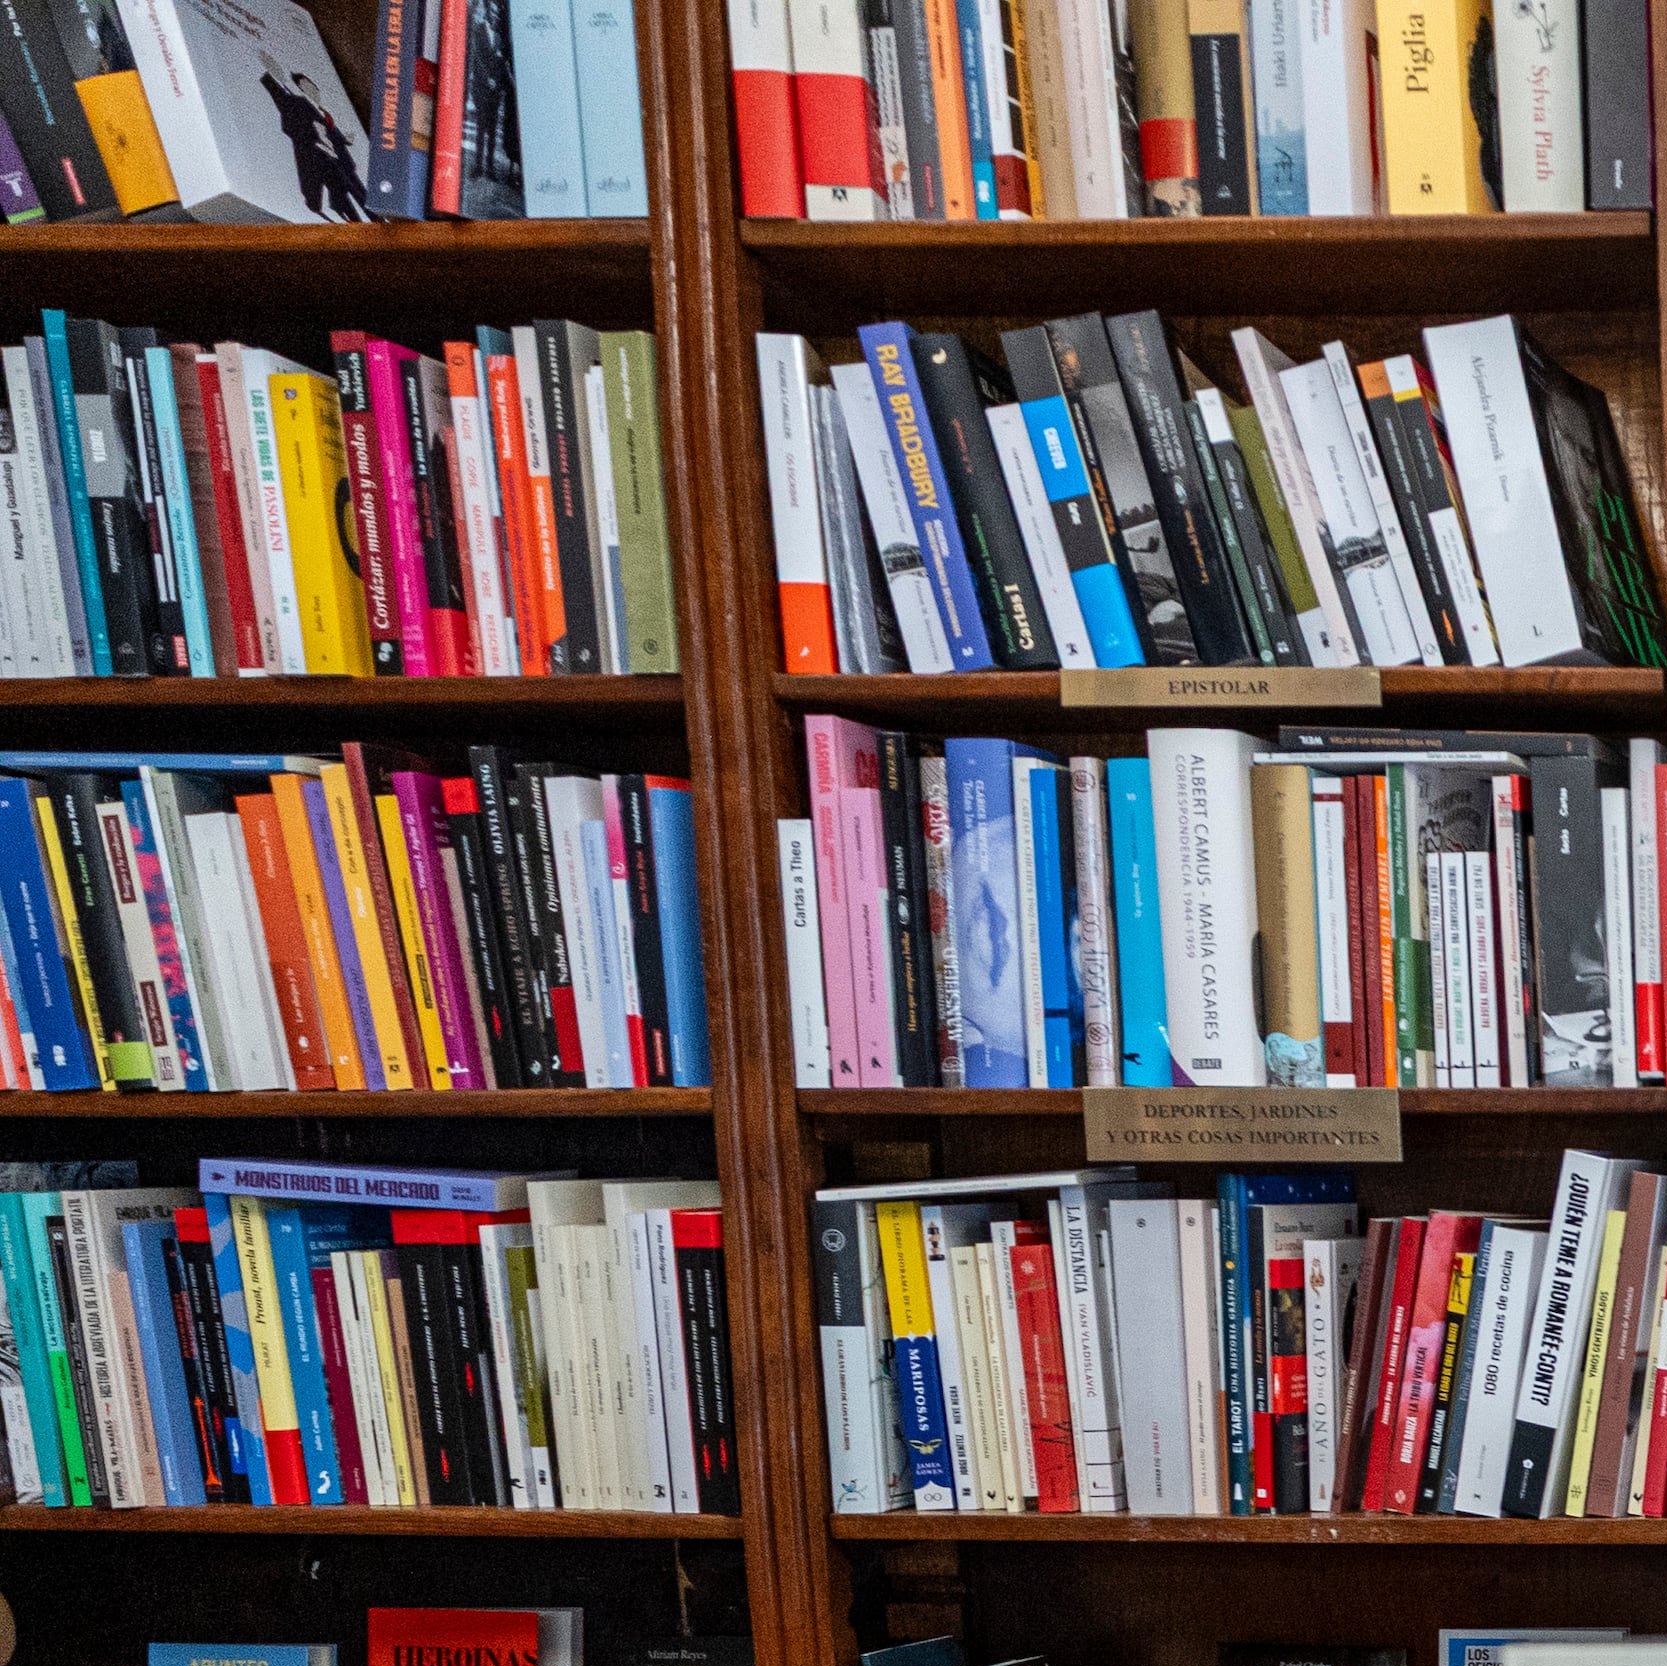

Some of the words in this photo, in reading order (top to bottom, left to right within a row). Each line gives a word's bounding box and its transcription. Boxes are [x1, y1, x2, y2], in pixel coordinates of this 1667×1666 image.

[1404, 14, 1434, 94] Piglia
[1531, 65, 1552, 124] Sylvia
[1536, 131, 1554, 182] Plath
[874, 341, 907, 390] RAY
[1472, 354, 1495, 412] Alejandra
[349, 422, 371, 476] modos
[887, 389, 939, 512] BRADBURY
[1483, 412, 1504, 462] Pizarnik
[355, 476, 373, 490] y
[357, 490, 380, 554] mundos
[365, 554, 389, 630] Cortázar:
[1168, 679, 1270, 694] EPISTOLAR
[1191, 754, 1209, 817] ALBERT
[528, 774, 550, 853] contundentes
[1194, 822, 1211, 886] CAMUS
[538, 852, 558, 913] Opiniones
[1197, 902, 1215, 959] MARÍA
[551, 932, 569, 983] Nabokov
[1200, 962, 1218, 1040] CASARES
[1143, 1103, 1245, 1120] DEPORTES,
[1249, 1103, 1338, 1120] JARDINES
[1106, 1130, 1118, 1145] Y
[1124, 1130, 1181, 1146] OTRAS
[1187, 1130, 1242, 1146] COSAS
[1248, 1130, 1380, 1146] IMPORTANTES
[234, 1170, 331, 1193] MONSTRUOS
[334, 1175, 360, 1195] DEL
[365, 1178, 440, 1201] MERCADO
[1561, 1172, 1589, 1228] ¿QUIÉN
[237, 1201, 254, 1247] familiar
[1064, 1201, 1081, 1224] LA
[244, 1247, 259, 1285] novela
[1067, 1226, 1089, 1294] DISTANCIA
[1553, 1266, 1573, 1280] A
[1555, 1228, 1580, 1267] TEME
[250, 1286, 265, 1325] Proust,
[1531, 1278, 1571, 1406] ROMANÉE-CONTI?
[908, 1347, 929, 1432] MARIPOSAS
[1229, 1400, 1242, 1435] TAROT
[1230, 1438, 1243, 1454] EL
[1467, 1648, 1490, 1661] LOS
